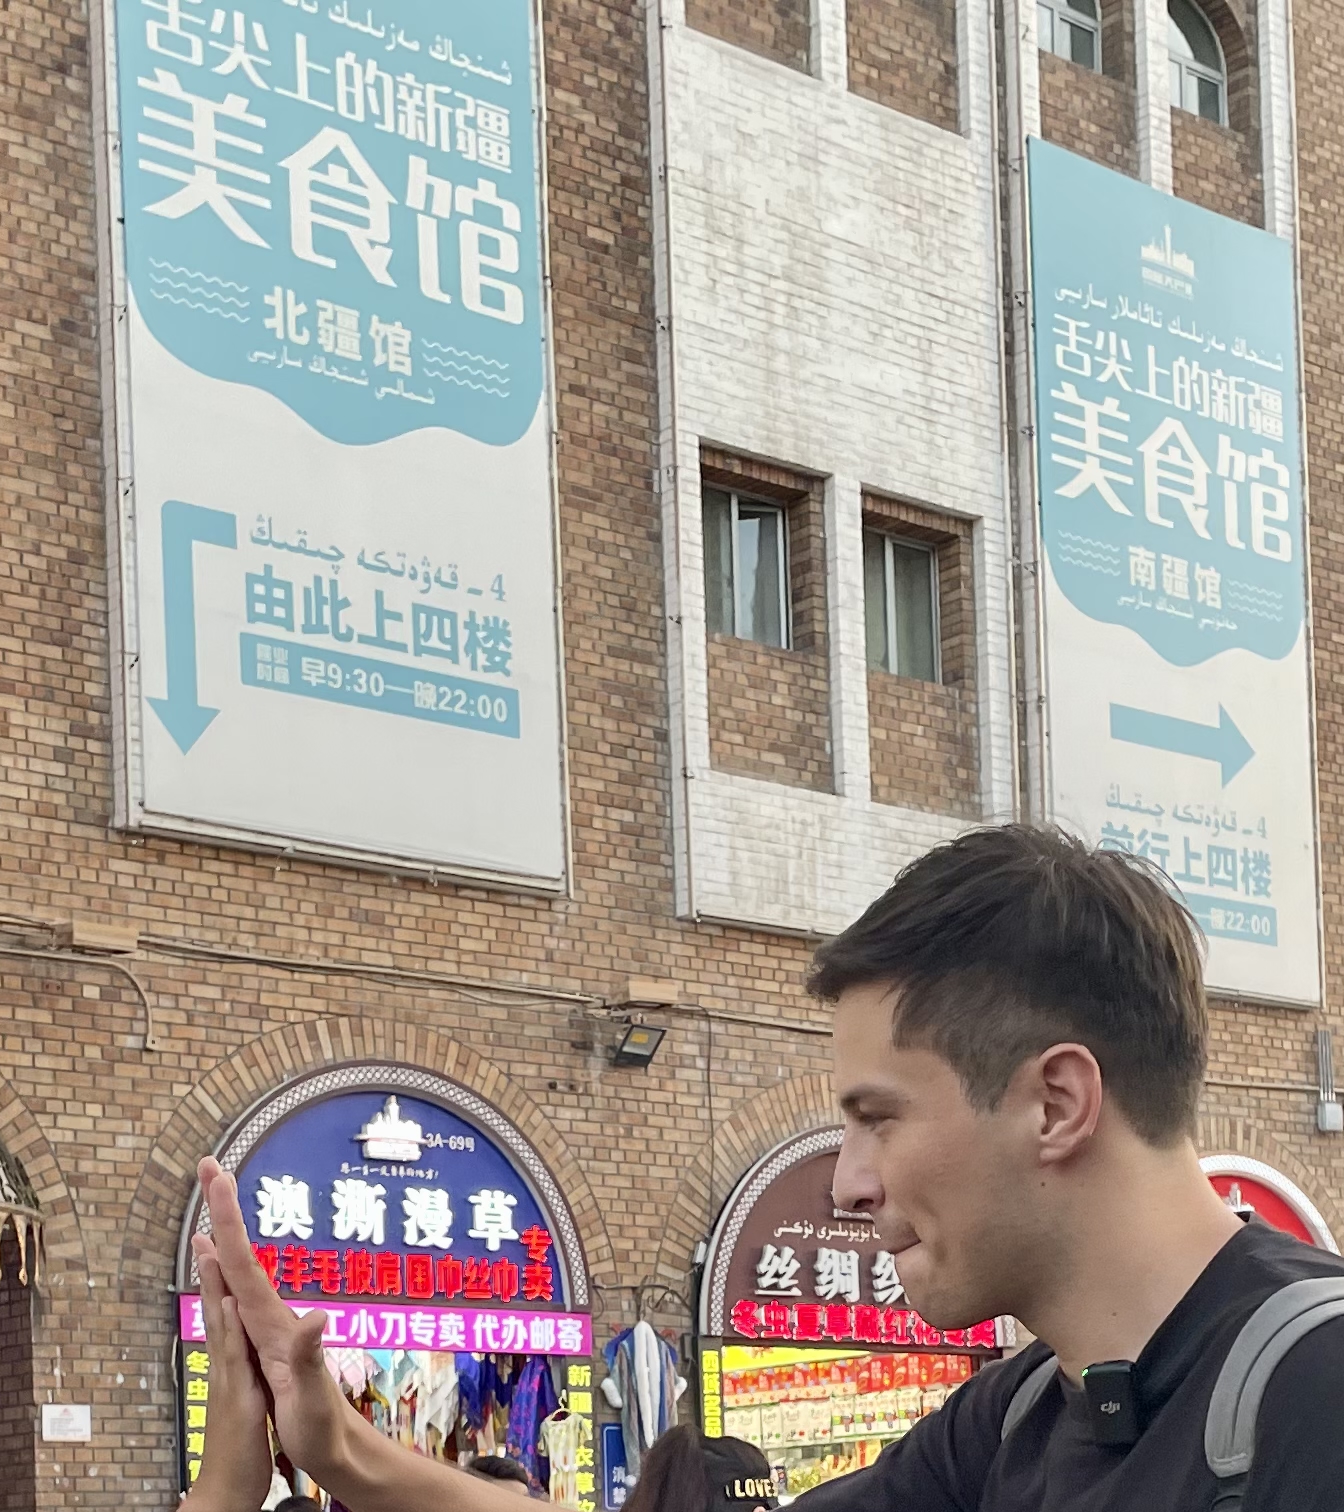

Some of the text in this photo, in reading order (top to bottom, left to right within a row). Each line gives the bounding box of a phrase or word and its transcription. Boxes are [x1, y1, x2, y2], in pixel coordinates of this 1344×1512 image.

[142, 0, 512, 174] 舌尖上的新疆
[136, 67, 525, 326] 美食馆
[262, 285, 413, 377] 北疆馆
[1052, 314, 1284, 442] 舌尖上的新疆
[1050, 381, 1293, 563] 美食馆
[244, 563, 513, 678] 由此上四楼
[1128, 545, 1222, 609] 南疆馆
[473, 1315, 583, 1352] 代办邮寄
